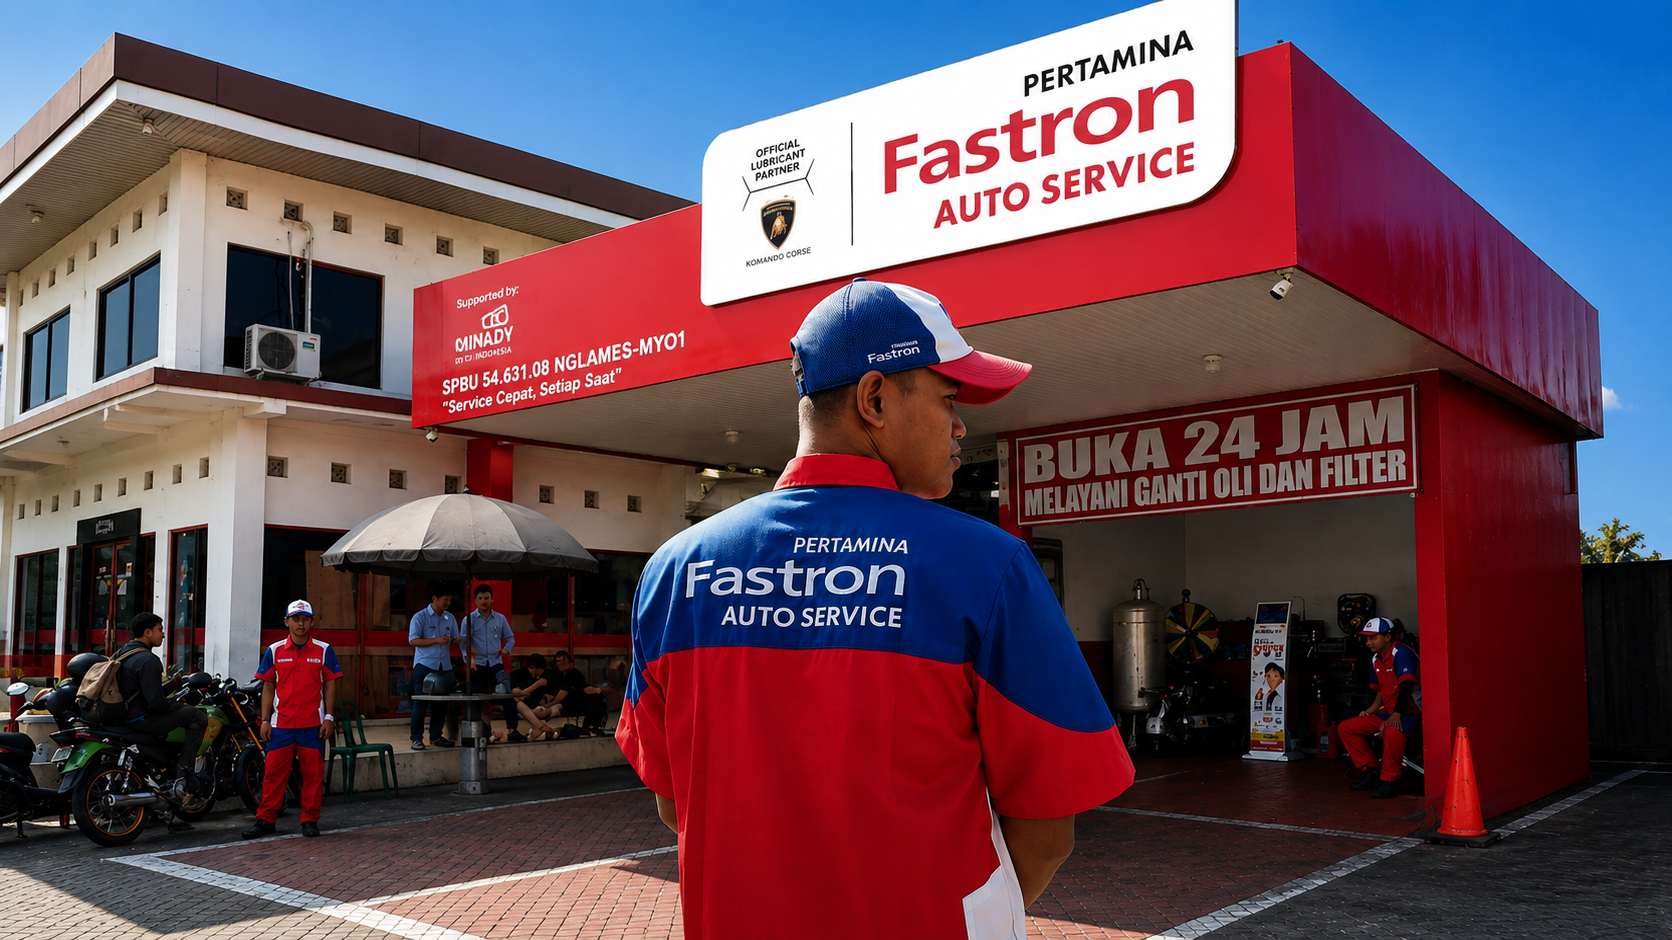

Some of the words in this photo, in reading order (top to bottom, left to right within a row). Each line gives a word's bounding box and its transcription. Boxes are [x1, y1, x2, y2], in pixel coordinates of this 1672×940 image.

[1024, 30, 1194, 97] PERTAMINA
[755, 138, 800, 158] OFFICIAL
[884, 78, 1195, 194] Fastron
[751, 148, 806, 171] LUBRICANT
[755, 162, 800, 182] PARTNER
[933, 182, 1030, 229] AUTO
[1041, 141, 1195, 204] SERVICE
[745, 253, 784, 267] KOMANDO
[786, 246, 811, 258] CORSE
[456, 287, 504, 309] Supported
[506, 285, 519, 298] by:
[455, 325, 514, 352] MINADY
[867, 344, 920, 364] Fastron
[442, 373, 479, 396] SPBU
[482, 360, 550, 387] 54.631.08
[496, 384, 536, 406] Cepat,
[540, 376, 581, 397] Setiap
[1024, 427, 1170, 484] BUKA
[1184, 415, 1260, 466] 24
[1275, 395, 1405, 456] JAM
[1024, 479, 1128, 517] MELAYANI
[1134, 470, 1207, 507] GANTI
[1213, 465, 1252, 499] OLI
[1259, 459, 1313, 494] DAN
[1320, 449, 1407, 488] FILTER
[793, 537, 908, 554] PERTAMINA
[685, 559, 906, 598] Fastron
[721, 605, 795, 628] AUTO
[801, 606, 903, 628] SERVICE
